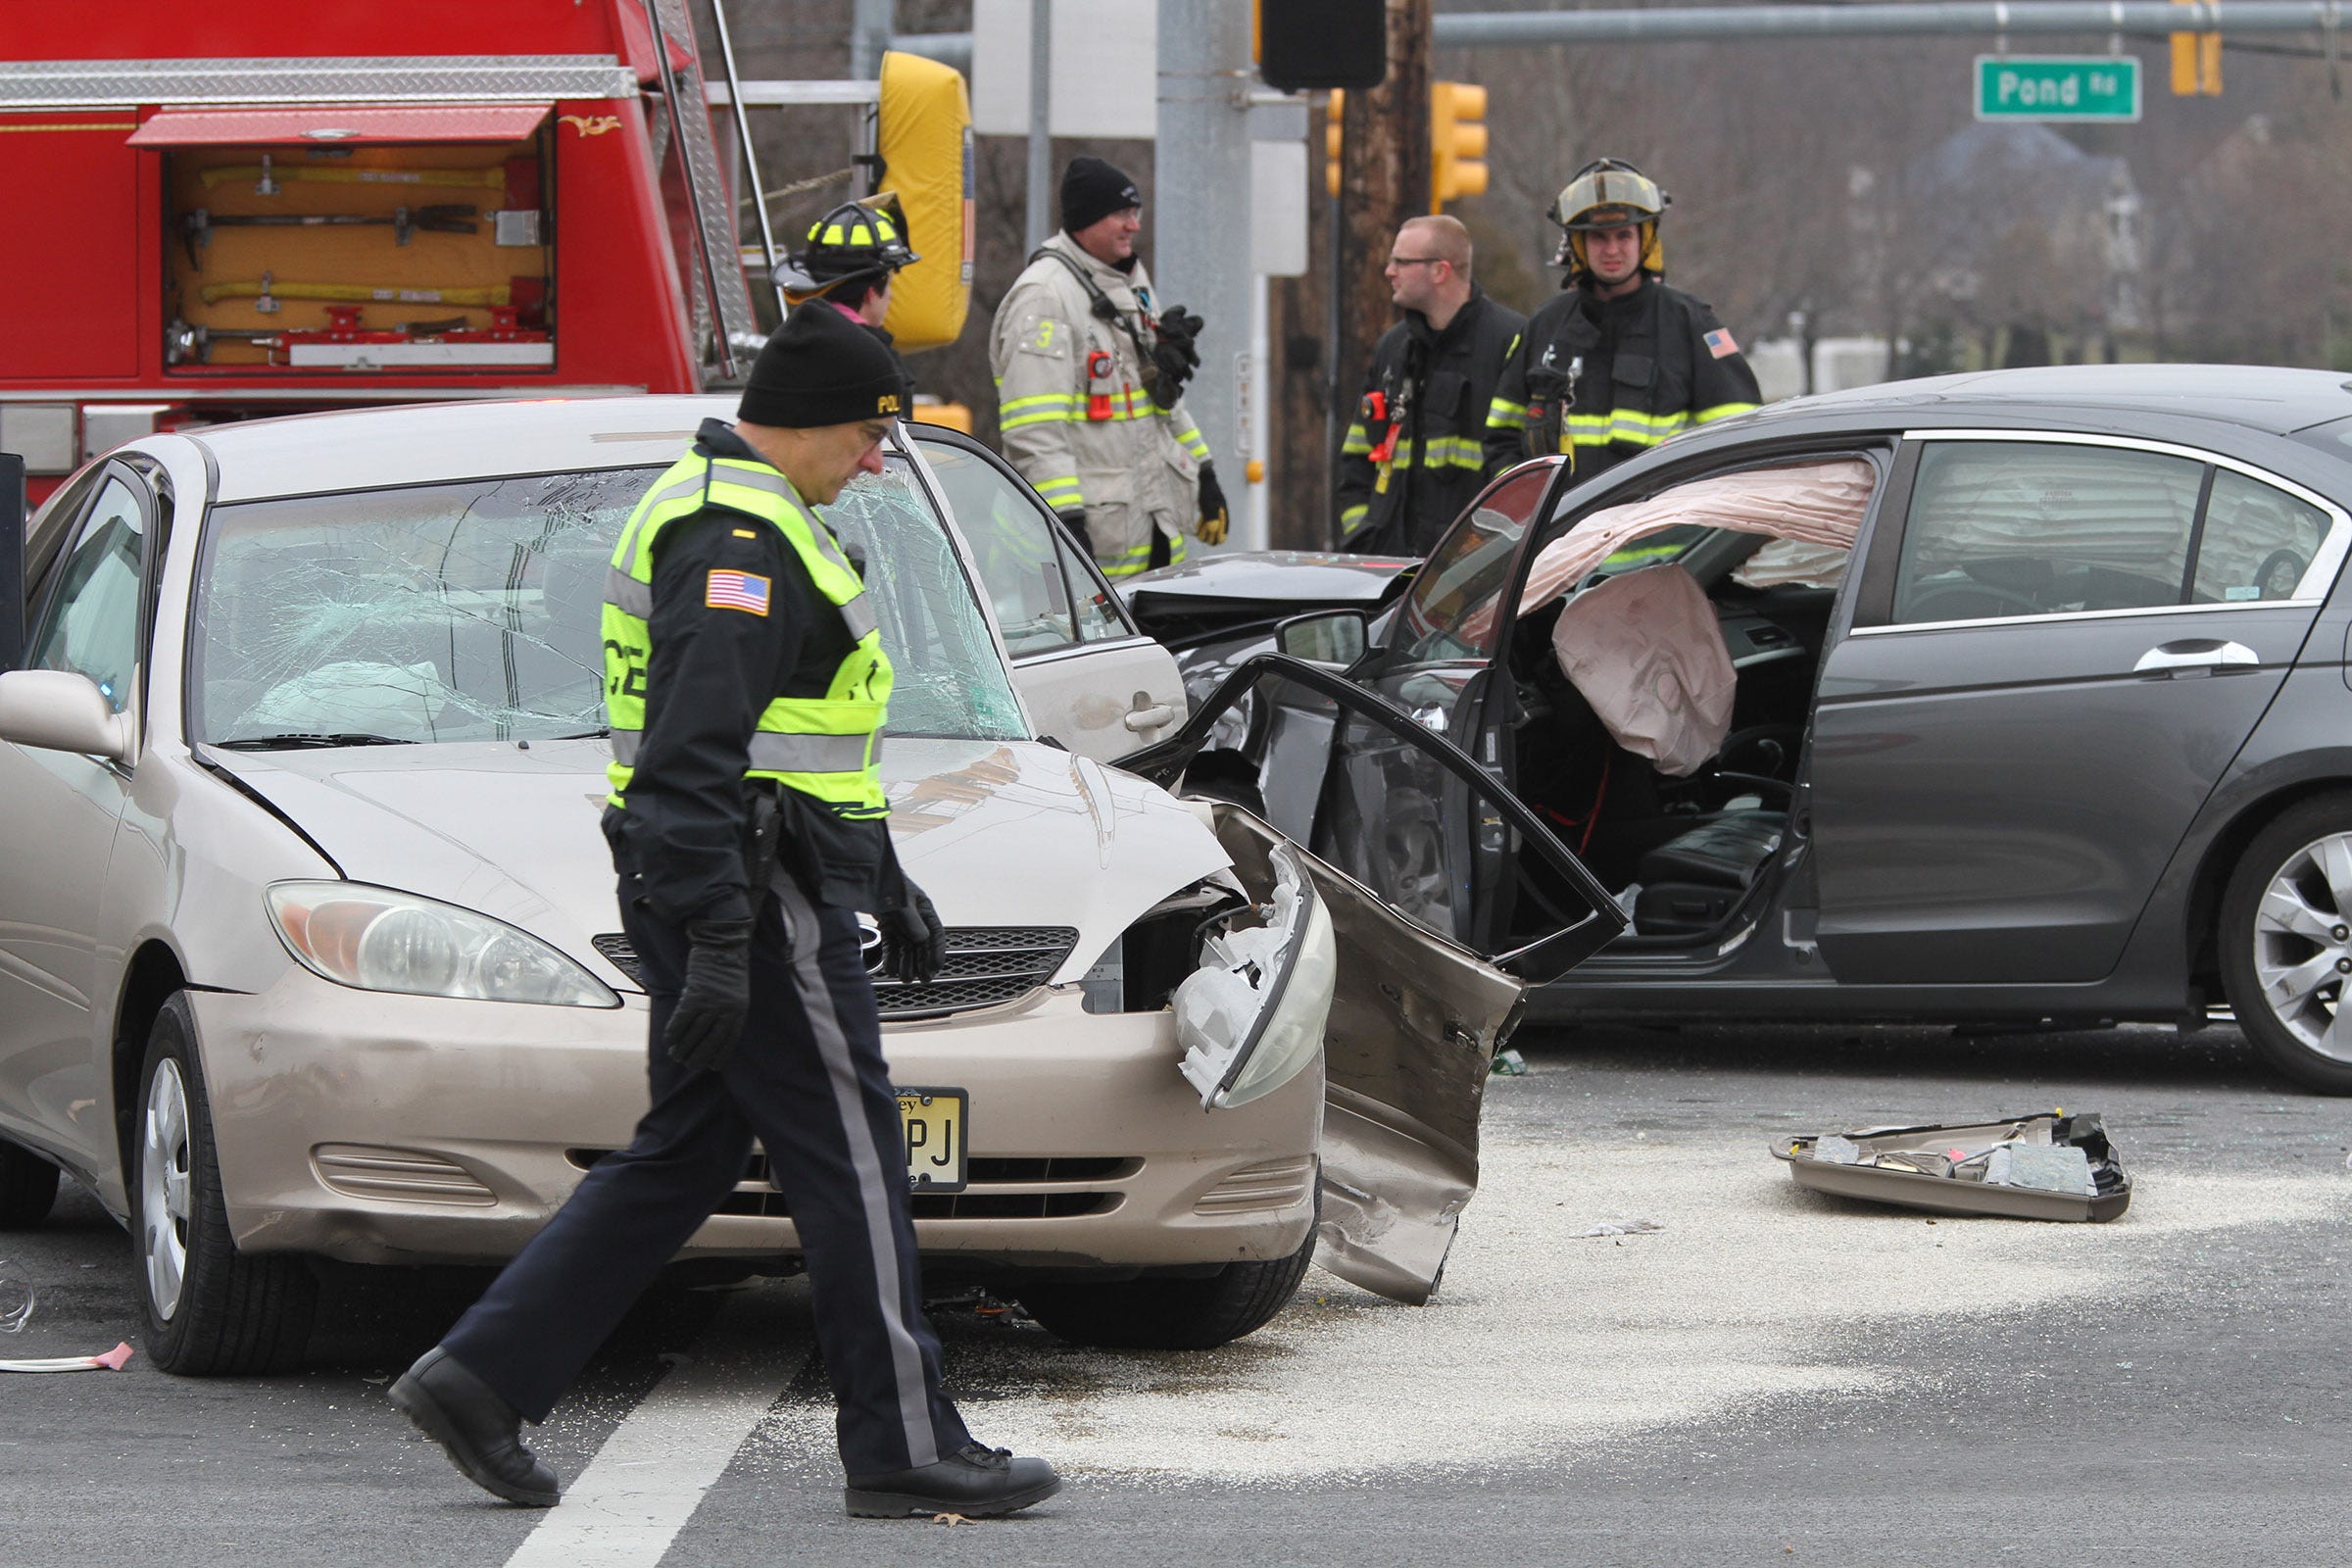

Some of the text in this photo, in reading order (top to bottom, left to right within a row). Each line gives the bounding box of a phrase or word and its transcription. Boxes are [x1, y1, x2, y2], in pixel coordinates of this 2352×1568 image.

[1997, 71, 2118, 106] Pond Rd
[1035, 320, 1054, 348] 3
